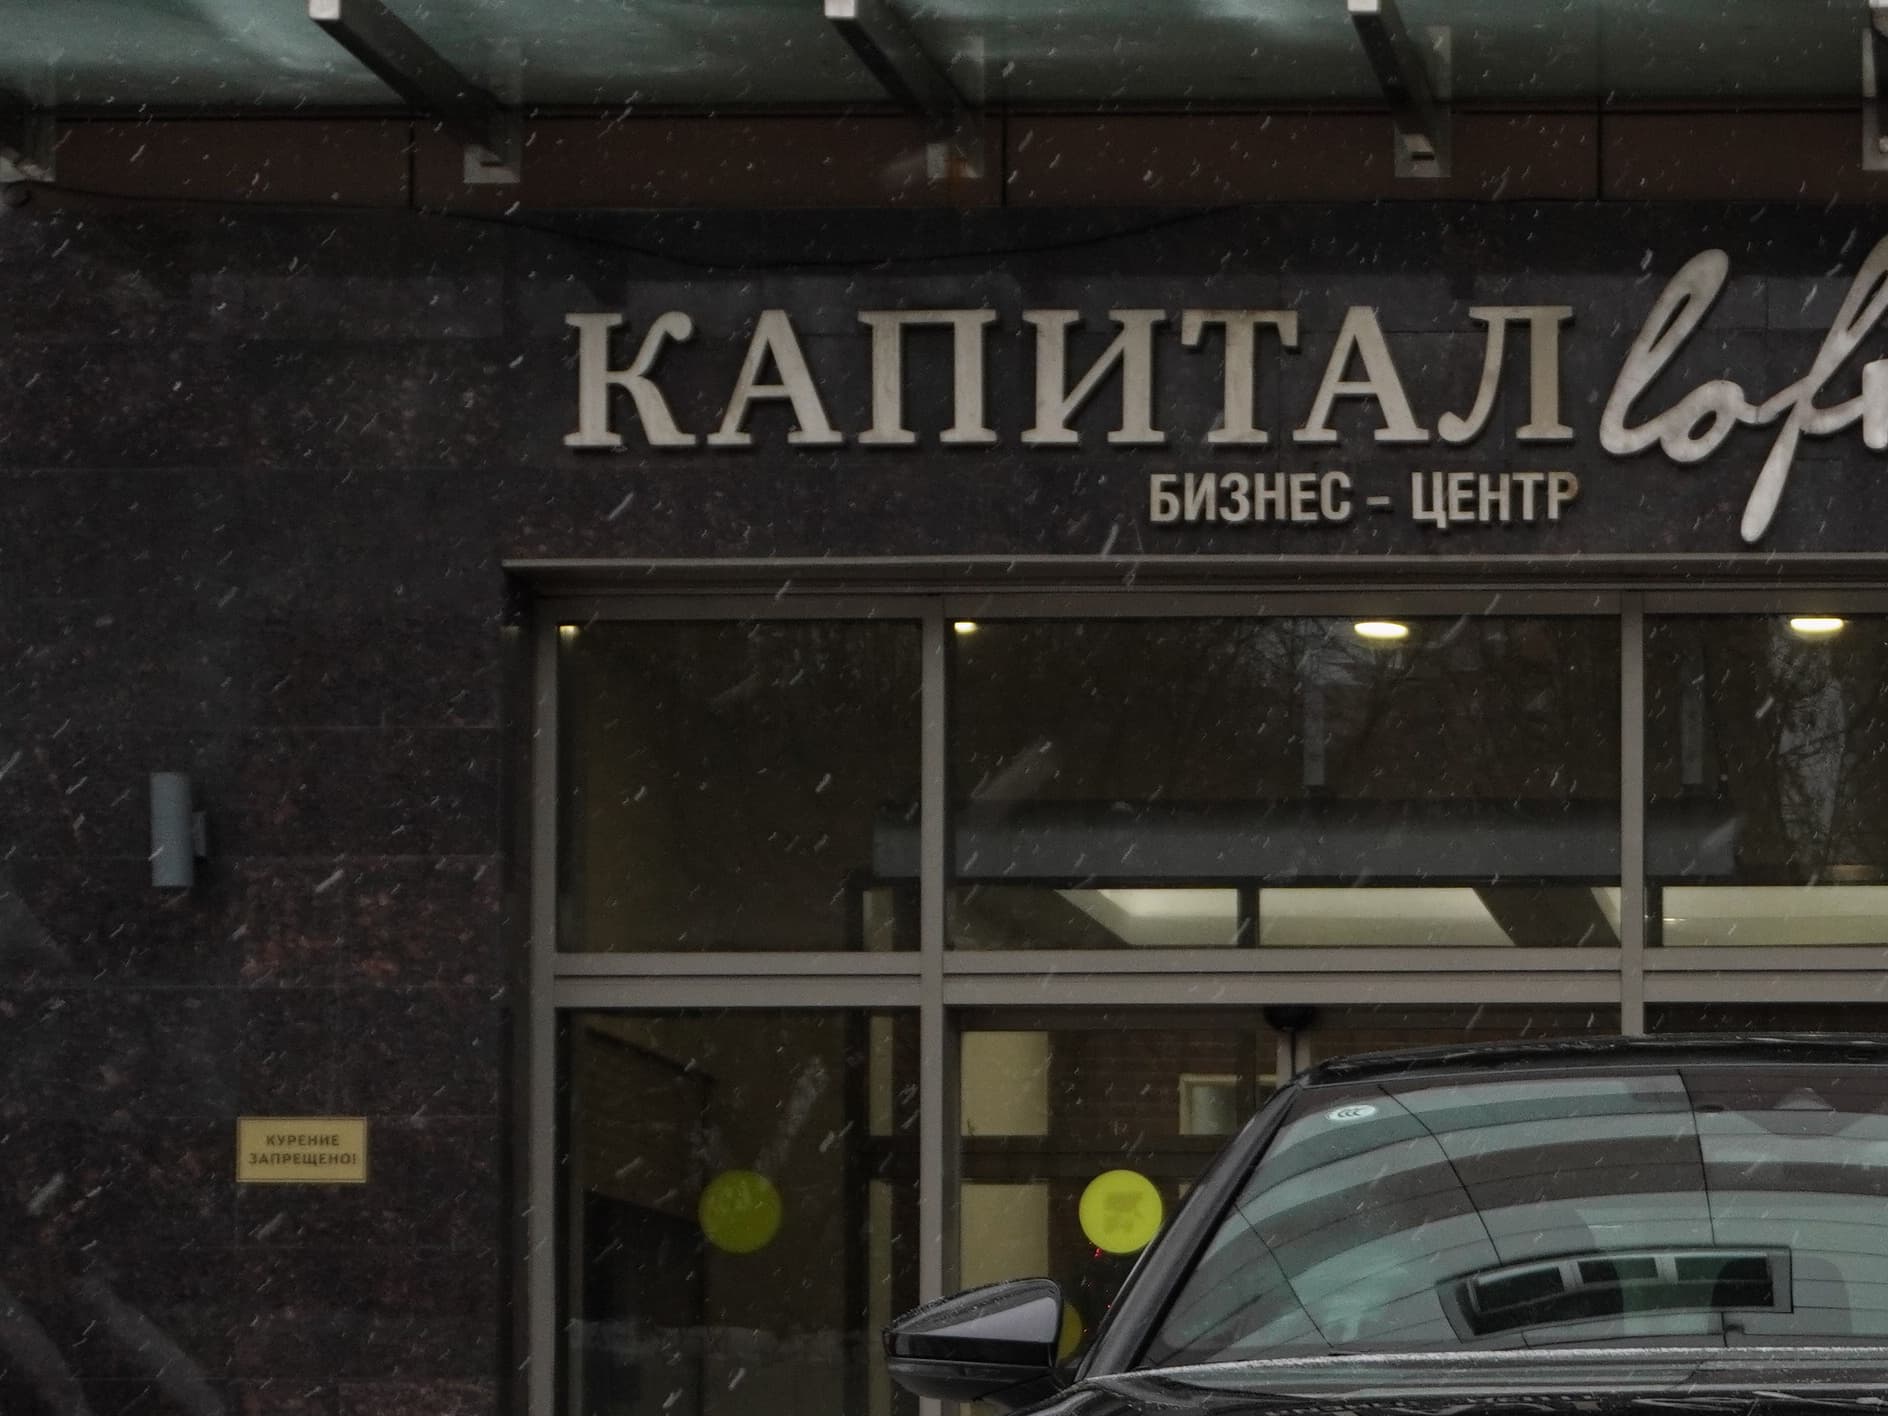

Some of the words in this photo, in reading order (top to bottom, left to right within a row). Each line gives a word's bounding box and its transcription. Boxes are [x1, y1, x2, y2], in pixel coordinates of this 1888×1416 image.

[564, 305, 1576, 449] КАПИТАЛ
[1150, 472, 1351, 522] БИЗНЕС
[1412, 472, 1578, 528] ЦЕНТР
[265, 1134, 340, 1146] КУРЕНИЕ
[248, 1152, 357, 1166] ЗАПРЕЩЕНО!
